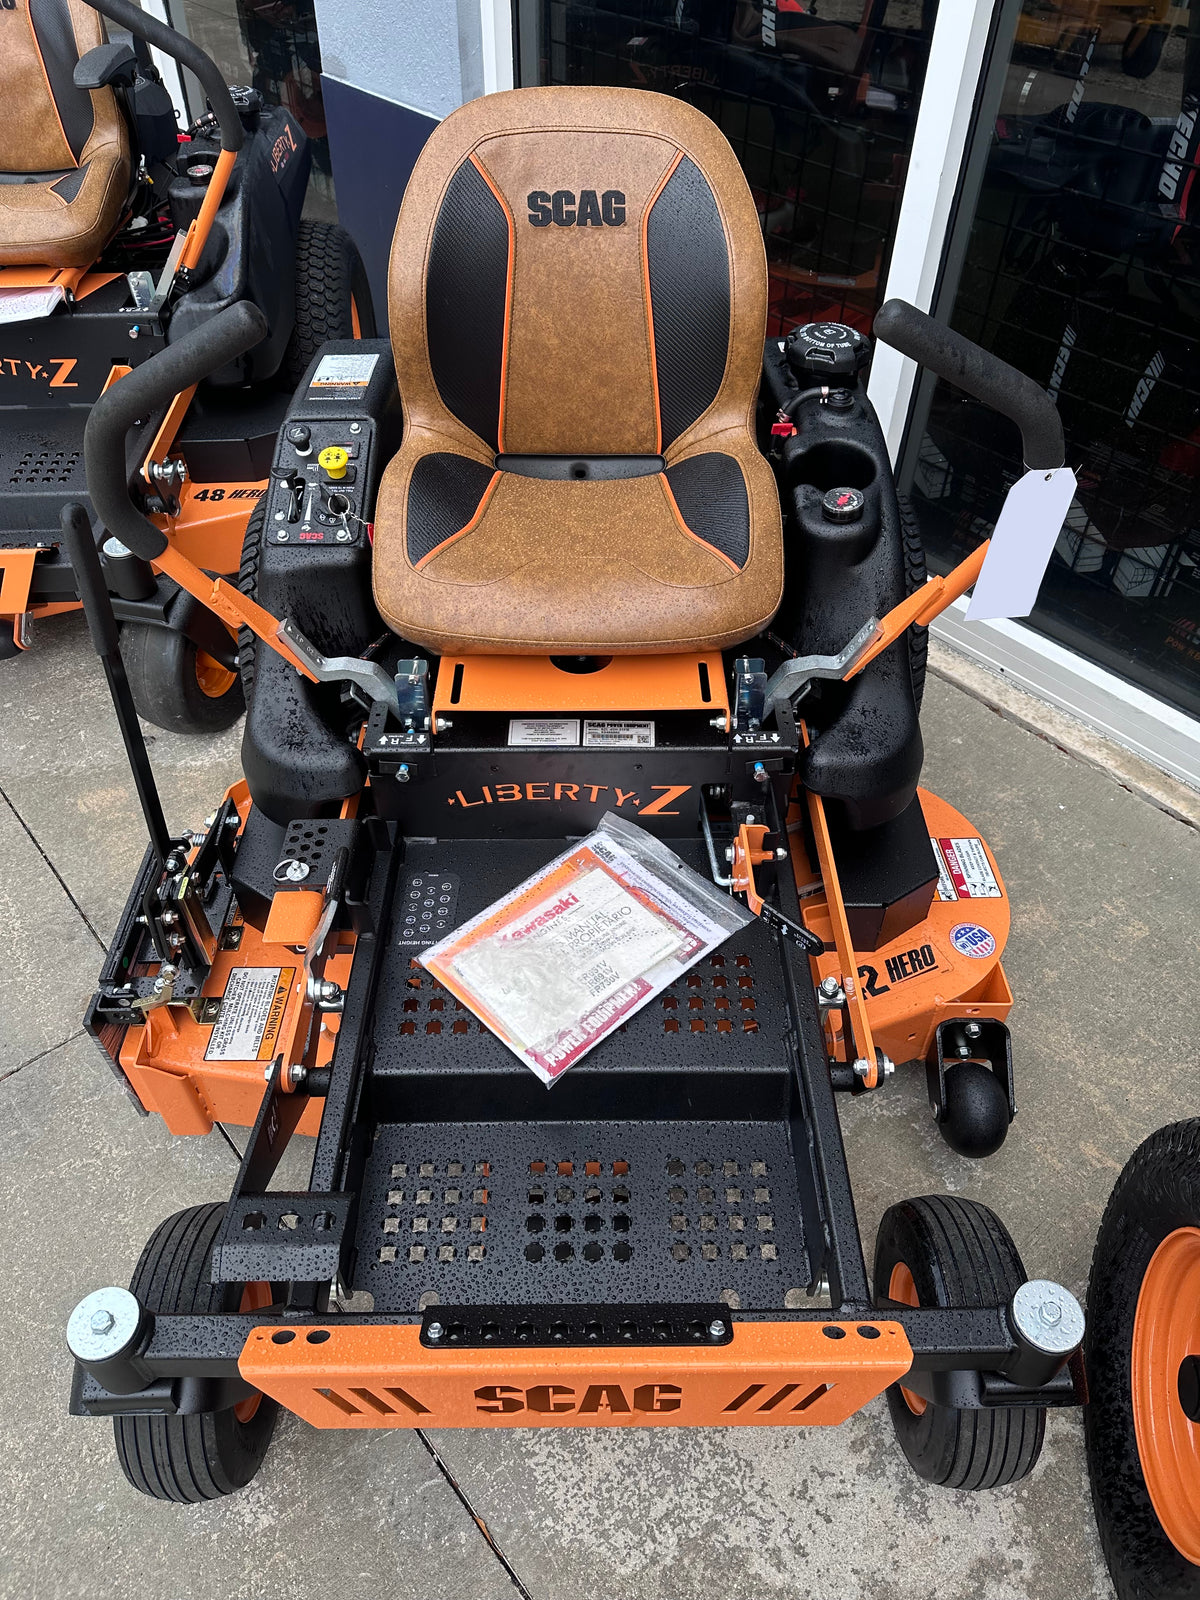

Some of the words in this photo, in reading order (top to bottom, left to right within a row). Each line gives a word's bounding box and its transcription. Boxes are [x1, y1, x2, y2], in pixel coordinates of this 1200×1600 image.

[527, 189, 626, 227] SCAG
[50, 358, 78, 388] Z
[194, 488, 226, 502] 48
[299, 532, 324, 540] SCAG
[456, 782, 636, 807] LIBERTY
[638, 786, 692, 814] Z
[946, 849, 961, 874] DANGER
[965, 928, 991, 946] USA
[884, 944, 936, 984] HERO
[267, 975, 277, 999] ROTATING
[261, 1001, 271, 1021] BLADES
[266, 996, 282, 1039] WARNING
[474, 1384, 682, 1416] SCAG
